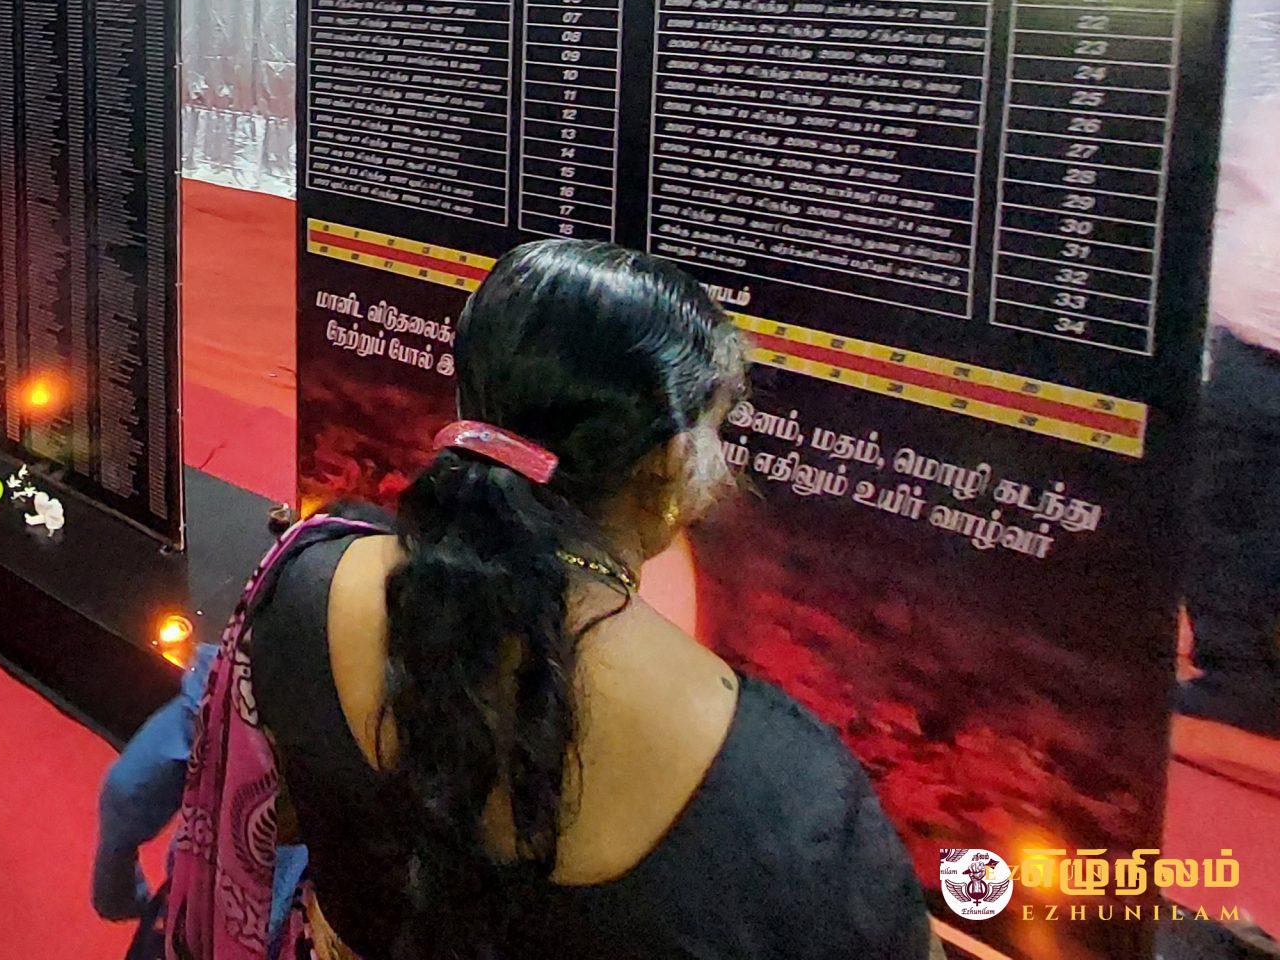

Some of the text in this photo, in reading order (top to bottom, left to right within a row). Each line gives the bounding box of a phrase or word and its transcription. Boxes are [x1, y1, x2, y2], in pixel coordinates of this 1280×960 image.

[562, 12, 583, 24] 07
[1076, 15, 1110, 30] 22
[561, 50, 581, 62] 09
[1073, 40, 1109, 56] 23
[561, 70, 579, 81] 10
[563, 89, 577, 101] 11
[1070, 91, 1106, 106] 25
[560, 109, 578, 120] 12
[1067, 117, 1102, 133] 26
[560, 128, 577, 140] 13
[559, 147, 576, 159] 14
[1066, 143, 1100, 159] 27
[558, 167, 576, 178] 15
[1061, 194, 1096, 210] 29
[558, 205, 575, 216] 17
[558, 223, 574, 235] 18
[1059, 218, 1094, 235] 30
[1060, 242, 1092, 259] 31
[1055, 268, 1090, 285] 32
[315, 290, 364, 319] மானிட
[1054, 292, 1088, 310] 33
[1054, 317, 1088, 335] 34
[326, 319, 388, 357] நேற்றுப்
[389, 344, 434, 370] போல்
[753, 451, 849, 497] எதிலும்
[852, 481, 928, 521] உயிர்
[893, 447, 993, 501] மொழி
[993, 479, 1103, 533] கடந்து
